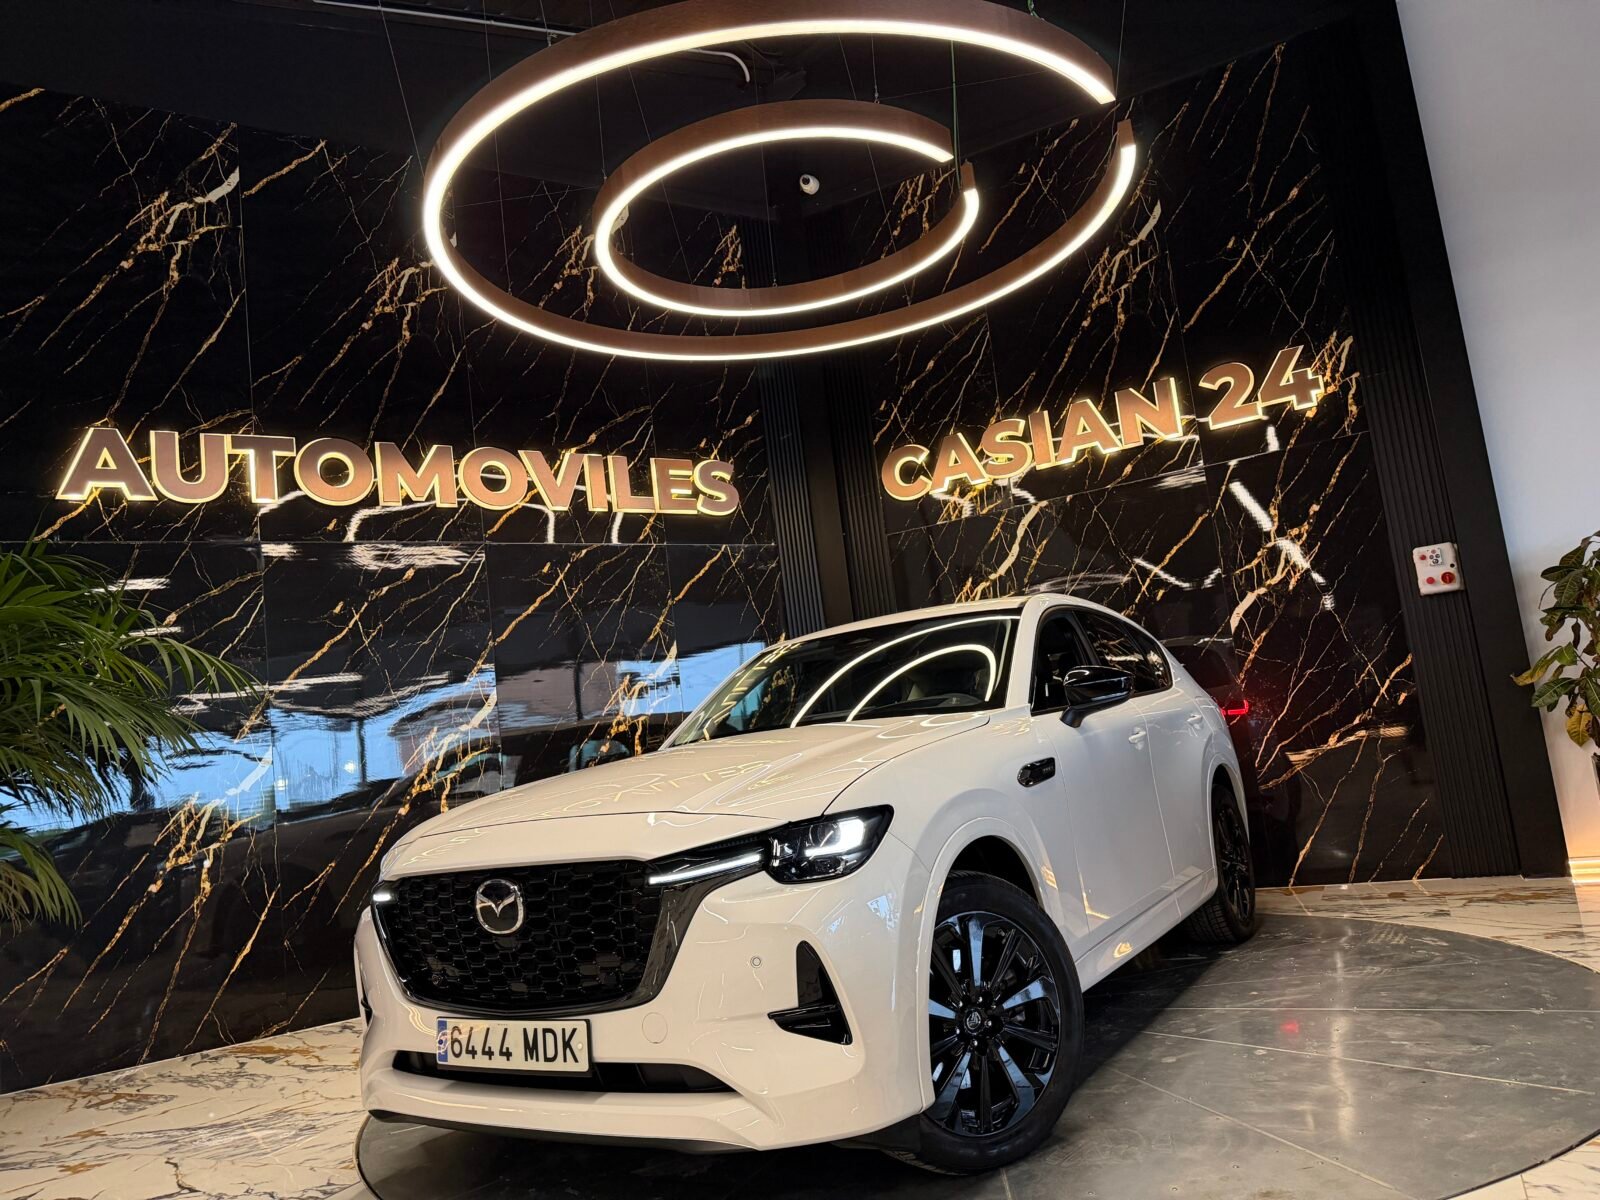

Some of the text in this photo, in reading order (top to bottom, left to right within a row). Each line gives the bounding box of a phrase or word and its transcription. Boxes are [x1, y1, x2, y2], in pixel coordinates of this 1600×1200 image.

[881, 345, 1324, 501] CASIAN 24
[56, 427, 739, 516] AUTOMOVILES
[450, 1026, 579, 1063] 6444 MDK
